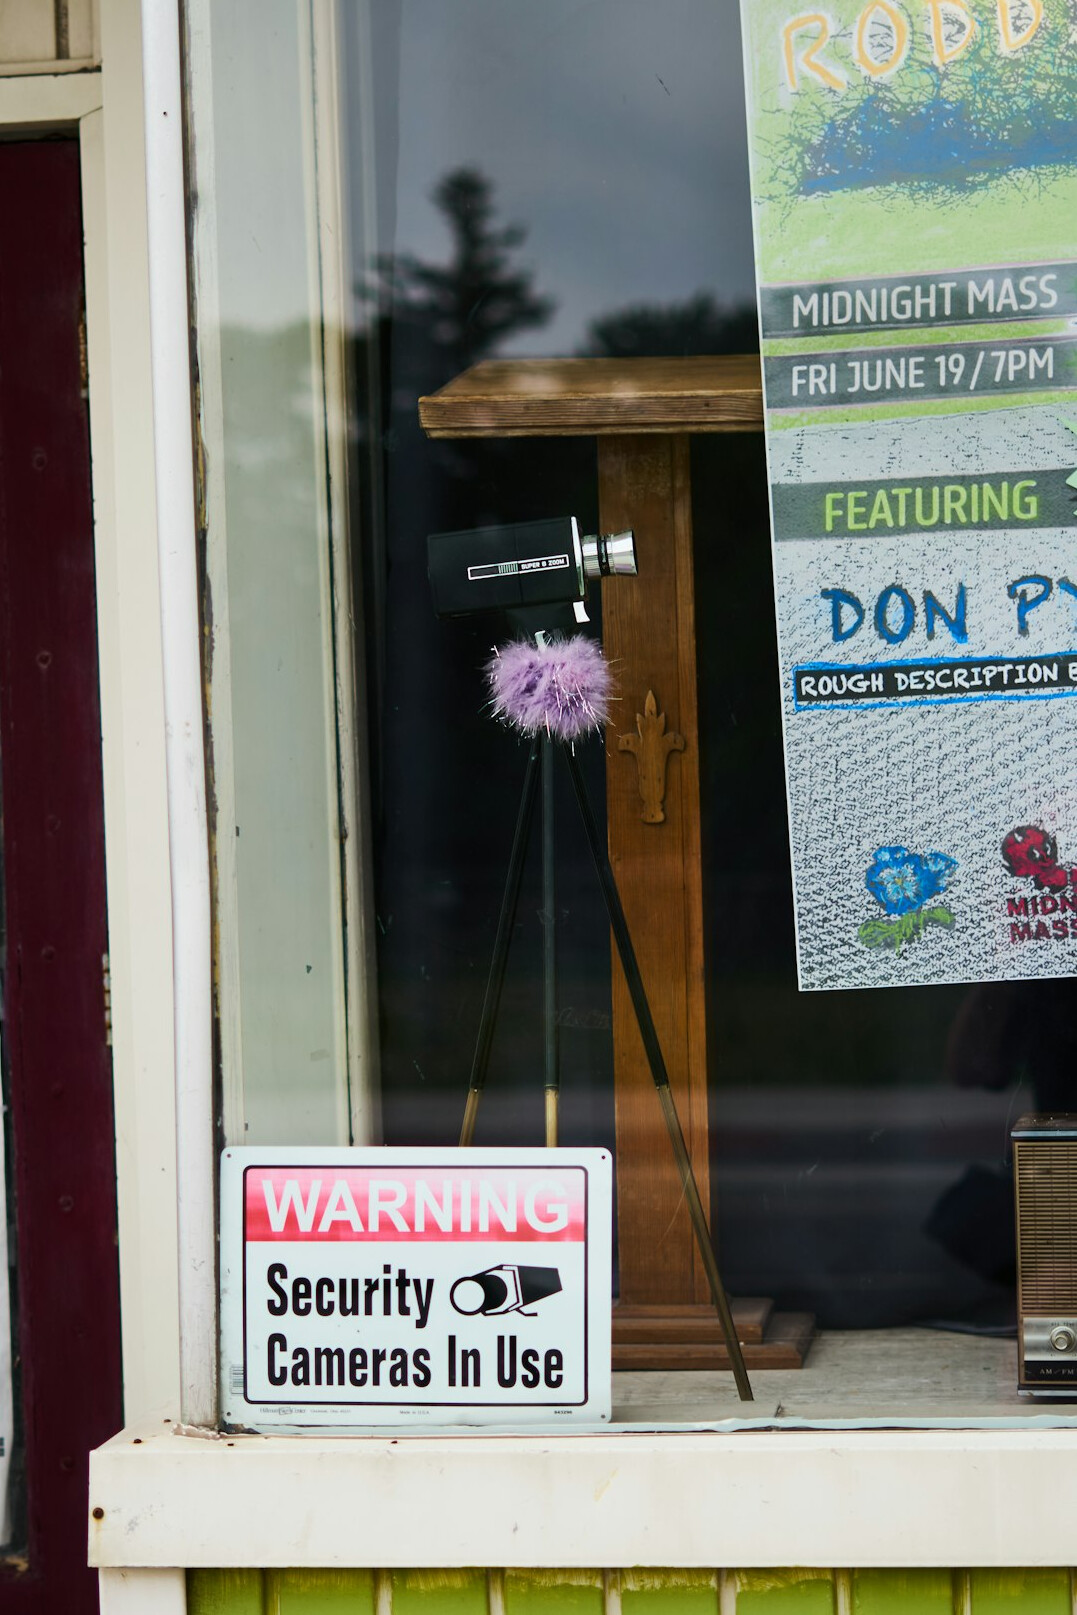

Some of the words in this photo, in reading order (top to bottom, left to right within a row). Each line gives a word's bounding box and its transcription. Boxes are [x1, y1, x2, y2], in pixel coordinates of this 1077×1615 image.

[792, 282, 957, 328] MIDNIGHT
[968, 274, 1058, 314] MASS
[791, 363, 836, 396] FRI
[847, 356, 925, 392] JUNE
[825, 480, 1038, 532] FEATURING
[521, 562, 540, 570] SUPER
[548, 558, 565, 566] ZOOM
[820, 580, 968, 644] DON
[799, 673, 884, 697] ROUGH
[894, 662, 1059, 690] DESCRIPTION
[262, 1178, 569, 1234] WARNING
[266, 1263, 435, 1329] Security
[266, 1333, 432, 1388] Cameras
[448, 1335, 481, 1387] In
[497, 1335, 564, 1388] Use
